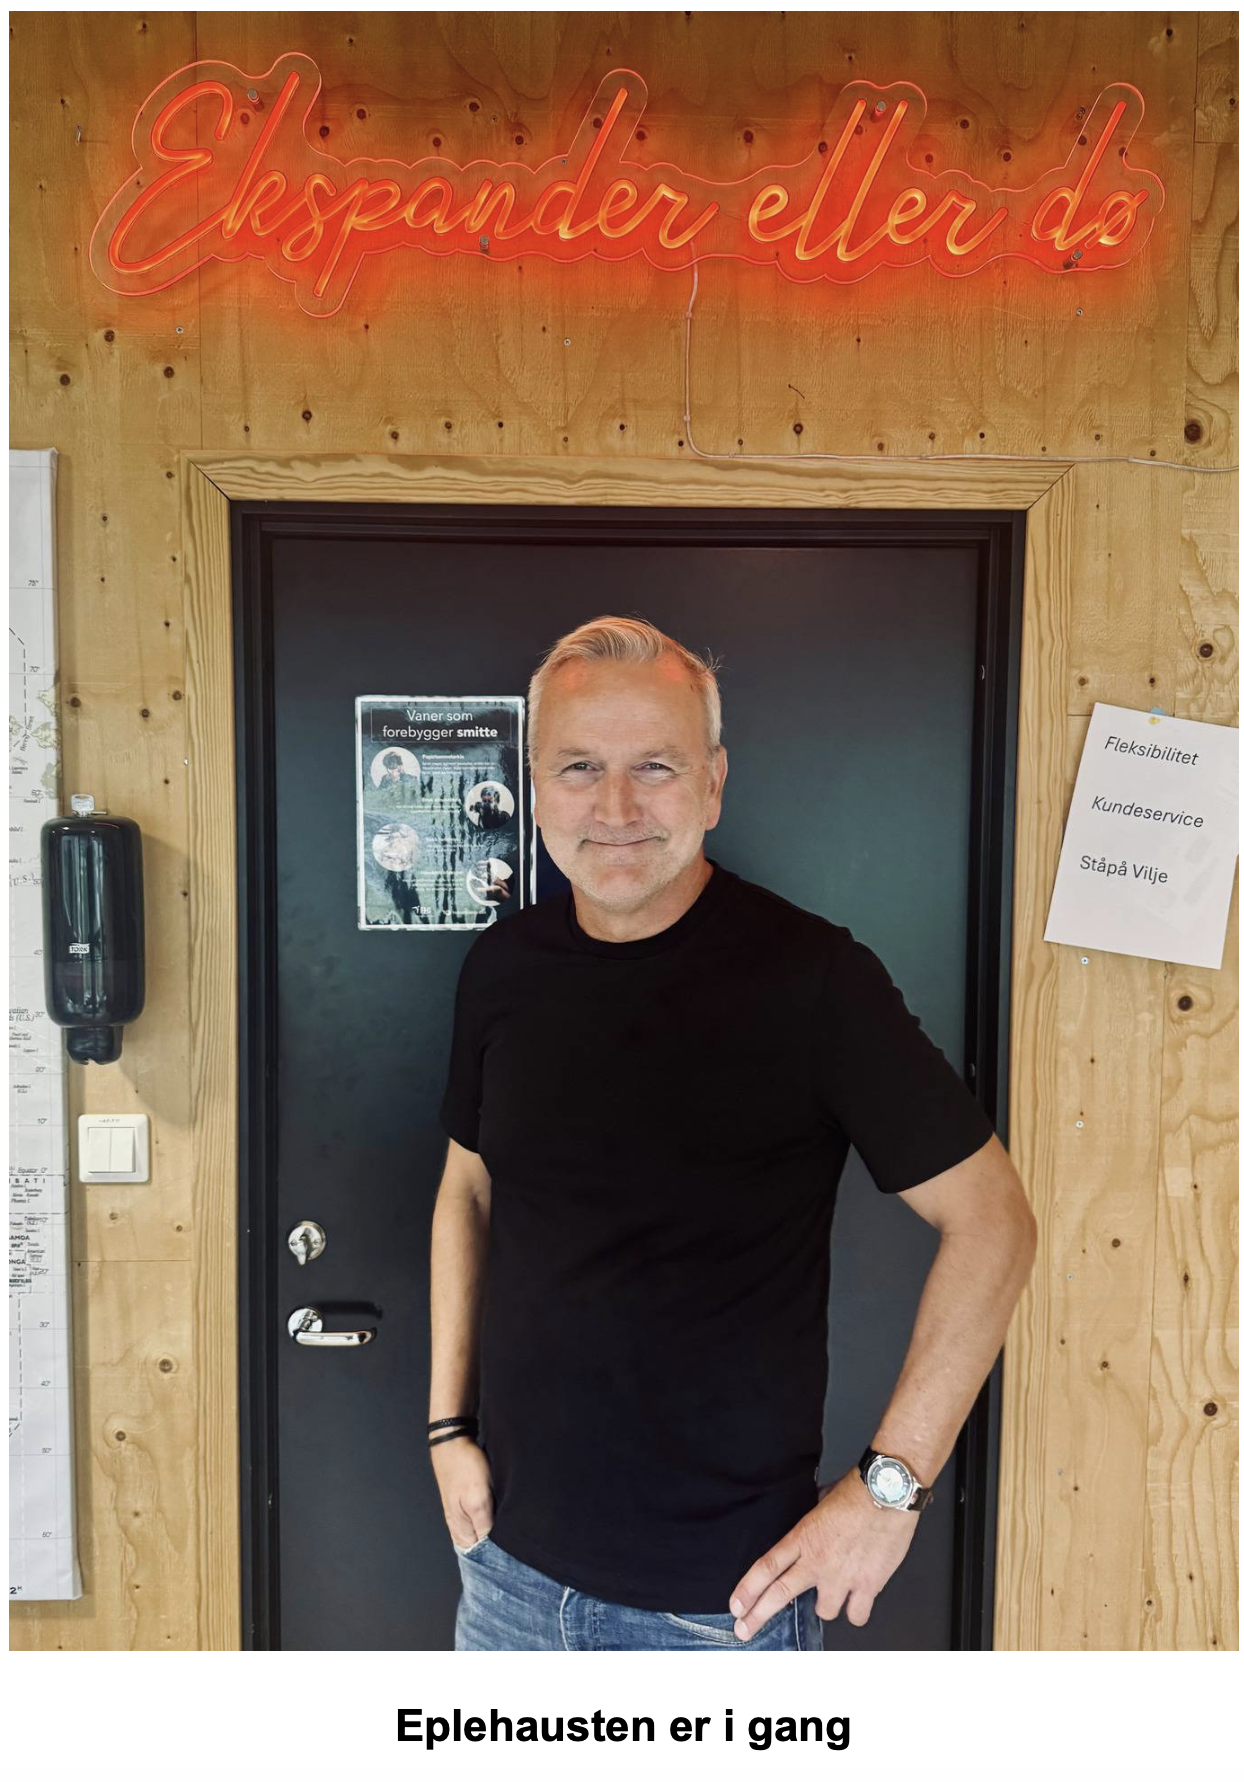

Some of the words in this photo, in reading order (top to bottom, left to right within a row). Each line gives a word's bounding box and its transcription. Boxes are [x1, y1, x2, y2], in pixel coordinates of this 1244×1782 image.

[108, 71, 720, 297] Ekspander
[748, 99, 1008, 262] eller
[1031, 100, 1150, 251] dø
[406, 709, 444, 721] Vaner
[446, 712, 473, 721] som
[382, 725, 454, 741] forebygger
[456, 726, 498, 738] smitte
[1104, 735, 1199, 766] Fleksibilitet
[1091, 795, 1204, 828] Kundeservice
[1079, 854, 1127, 877] Ståpå
[1133, 863, 1168, 885] Vilje
